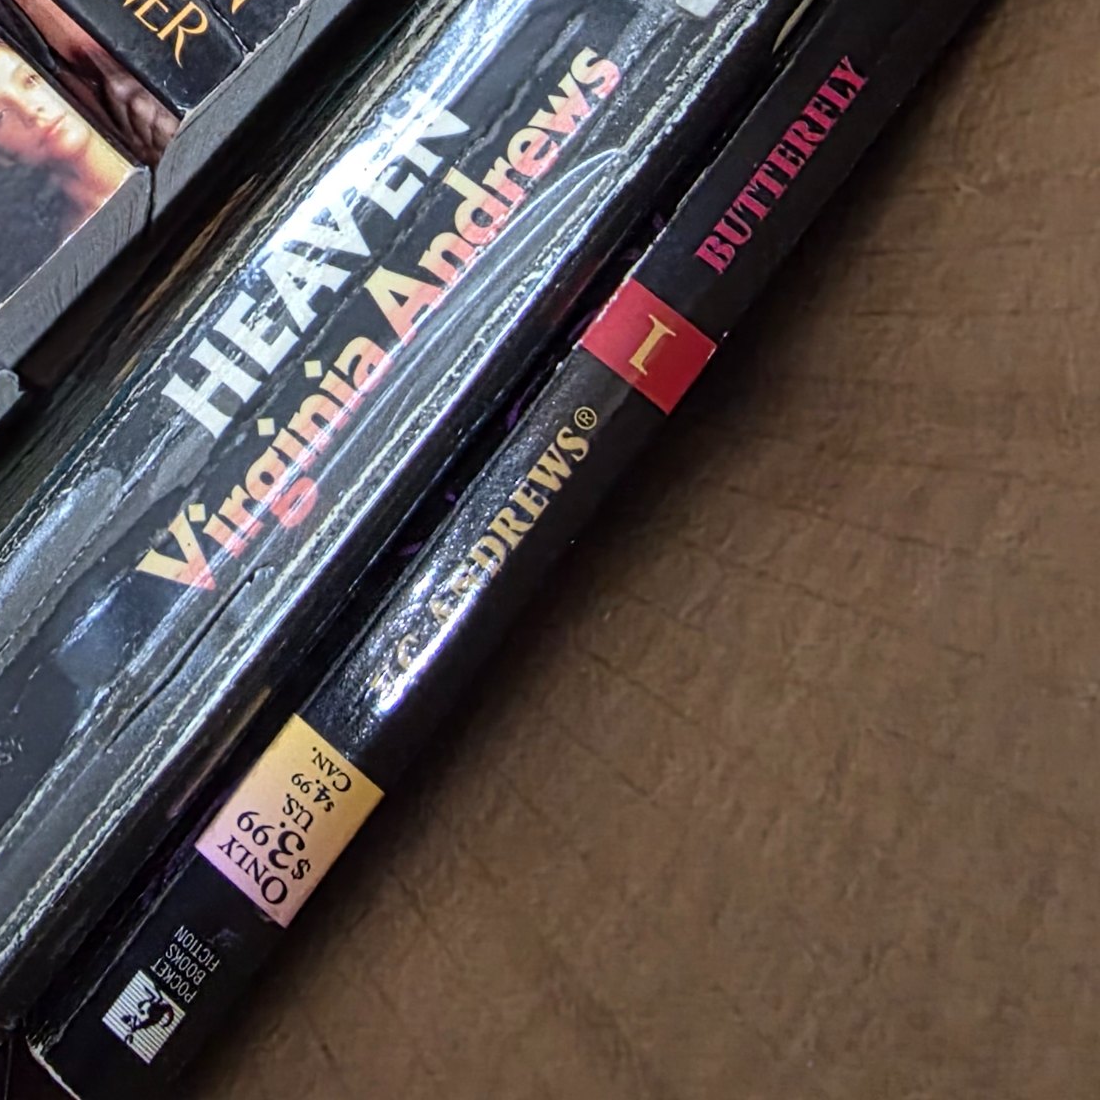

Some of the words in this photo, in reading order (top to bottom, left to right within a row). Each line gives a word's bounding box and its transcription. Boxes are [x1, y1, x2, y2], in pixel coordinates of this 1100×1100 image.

[694, 55, 870, 276] BUTTERFLY
[161, 108, 471, 439] HEAVEN
[136, 336, 394, 591] Virginia
[363, 47, 622, 347] Andrews
[291, 772, 335, 812] $4.99
[311, 746, 352, 793] CAN.
[282, 793, 314, 833] U.S.
[237, 811, 311, 880] $3.99
[217, 835, 288, 904] ONLY
[165, 944, 206, 986] BOOKS
[174, 925, 221, 971] FICTION
[150, 957, 197, 1003] POCKET
